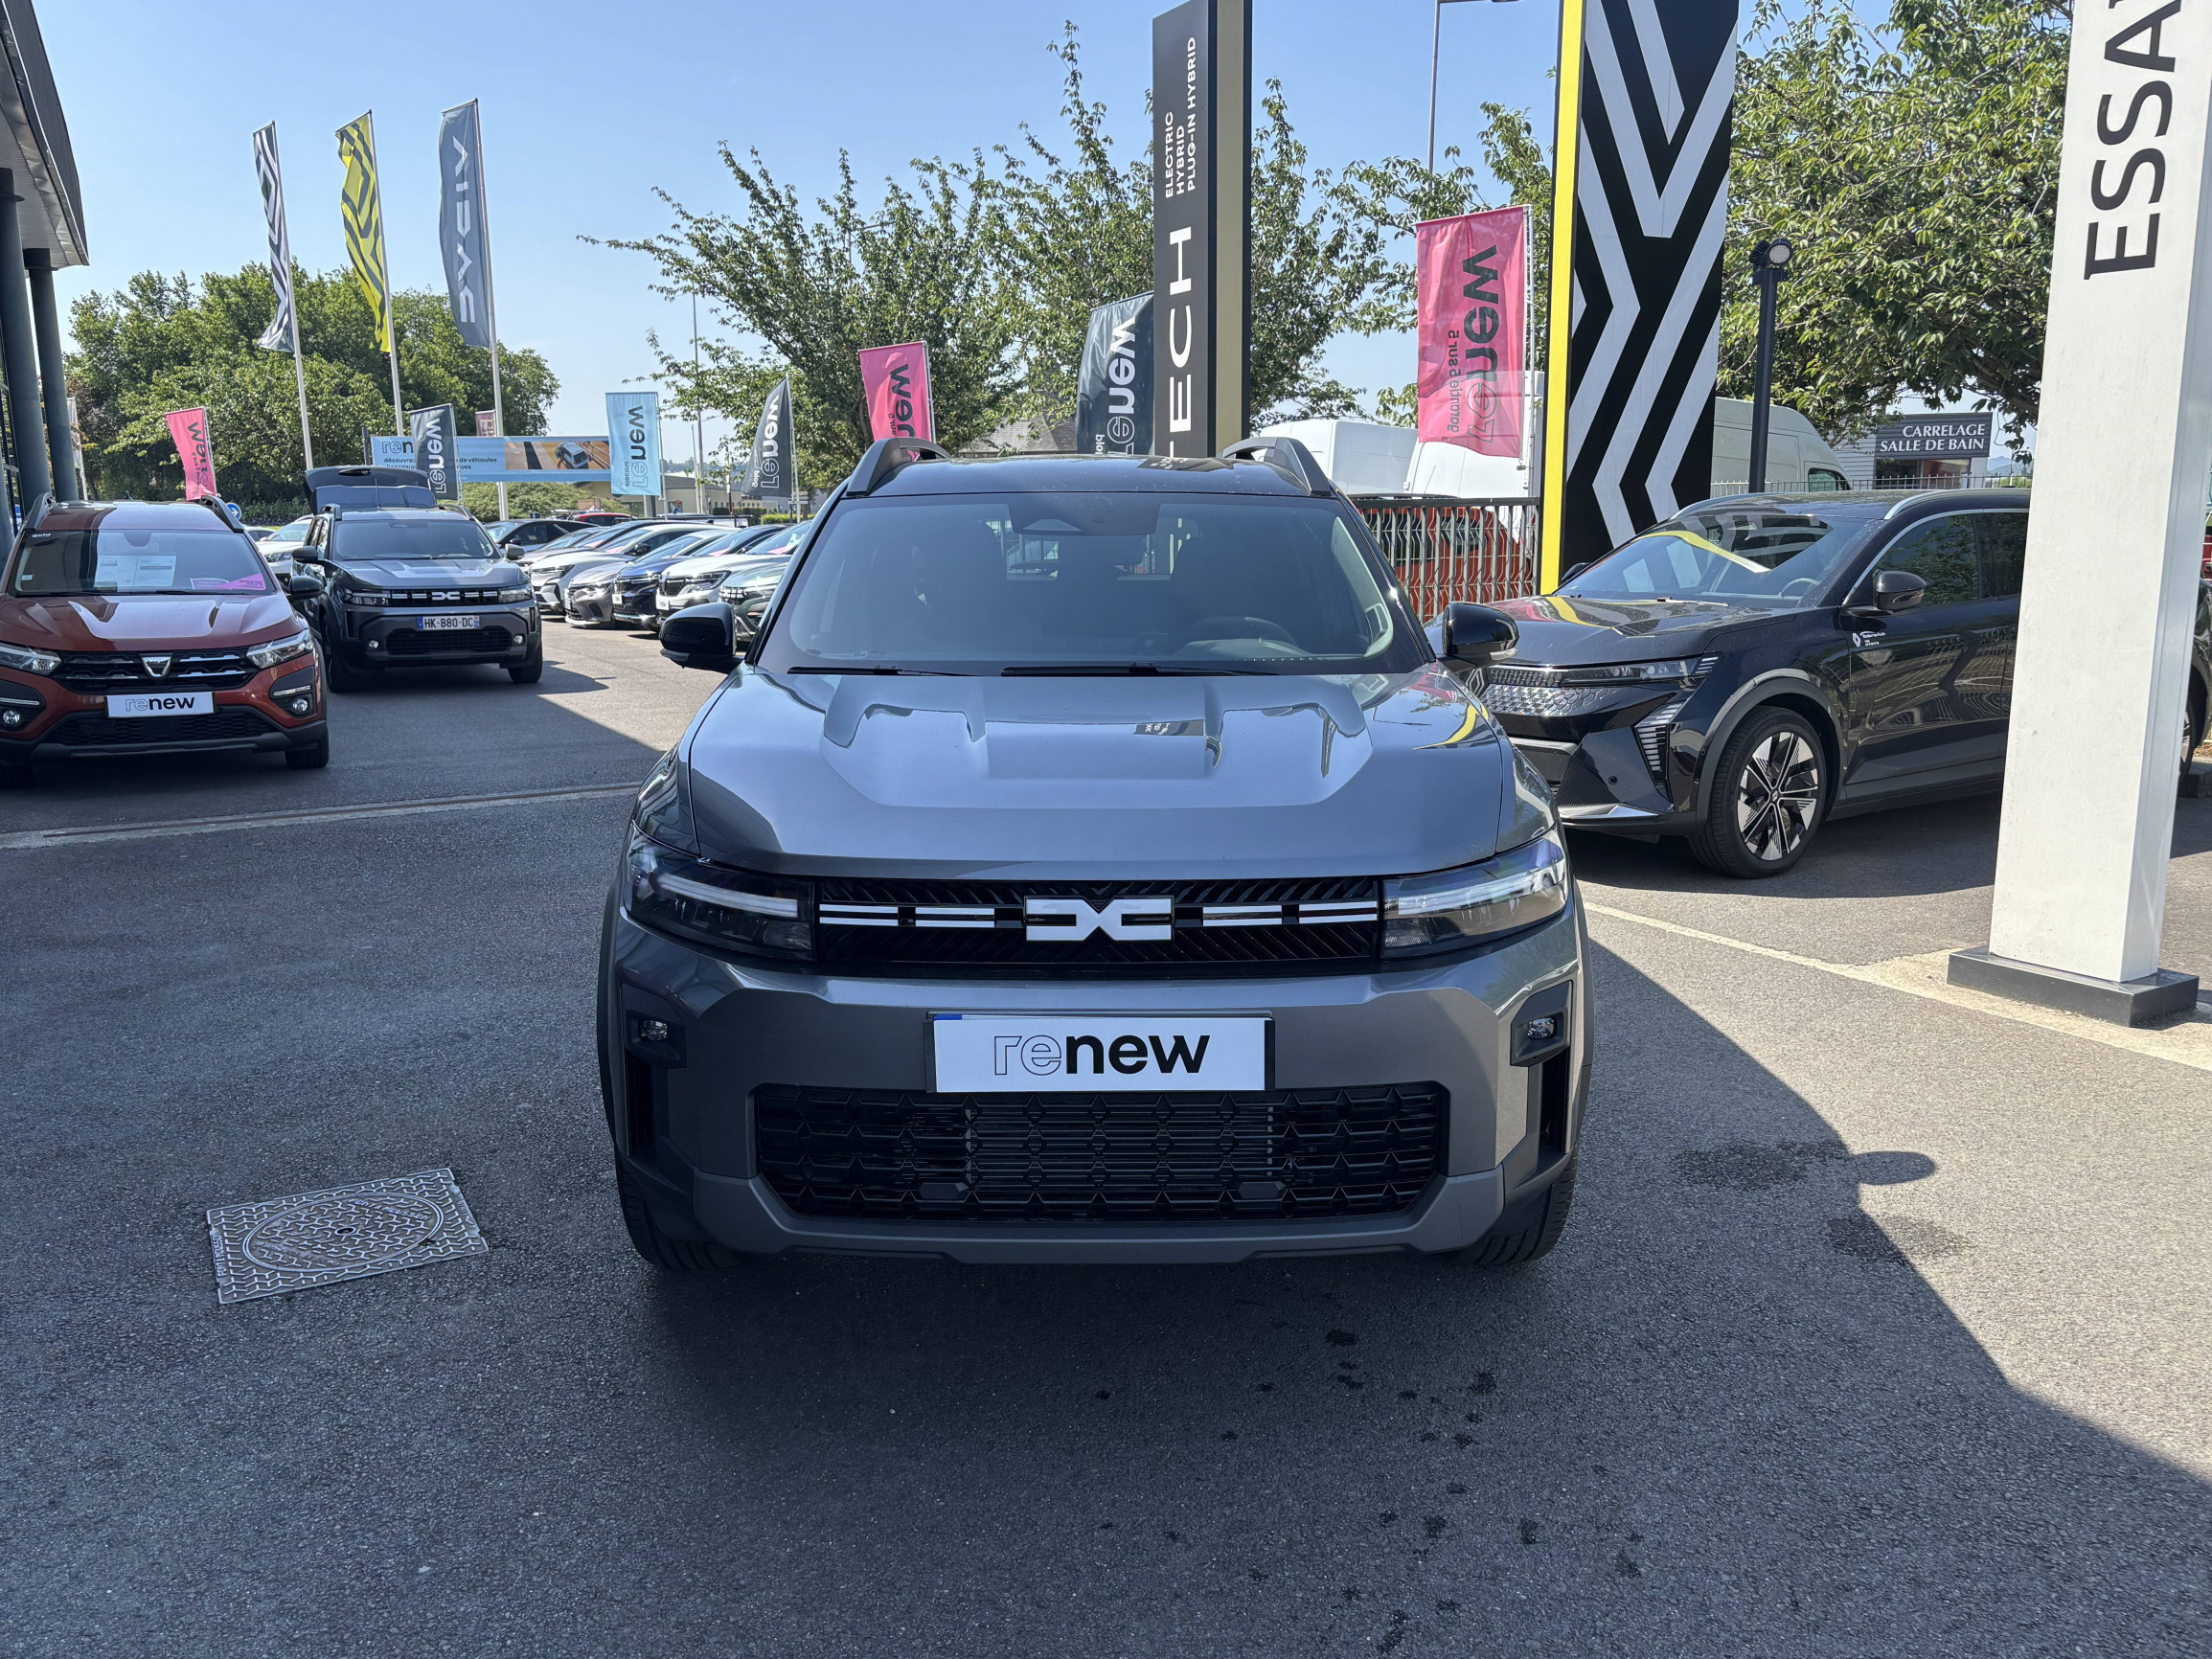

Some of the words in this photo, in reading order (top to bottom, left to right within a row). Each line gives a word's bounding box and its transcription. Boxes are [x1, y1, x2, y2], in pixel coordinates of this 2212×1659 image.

[1187, 36, 1196, 110] HYBRID
[1165, 111, 1174, 198] ELECTRIC
[1176, 125, 1185, 194] HYBRID
[1187, 113, 1196, 192] PLUG-IN
[2084, 0, 2181, 280] ESSA
[1169, 226, 1192, 458] ECH
[1880, 440, 1922, 452] SALLE
[1925, 439, 1946, 451] DE
[1948, 438, 1985, 450] BAIN
[1902, 423, 1986, 438] CARRELAGE
[424, 617, 474, 629] HK-880-DC
[125, 696, 195, 712] renew
[993, 1034, 1211, 1076] renew
